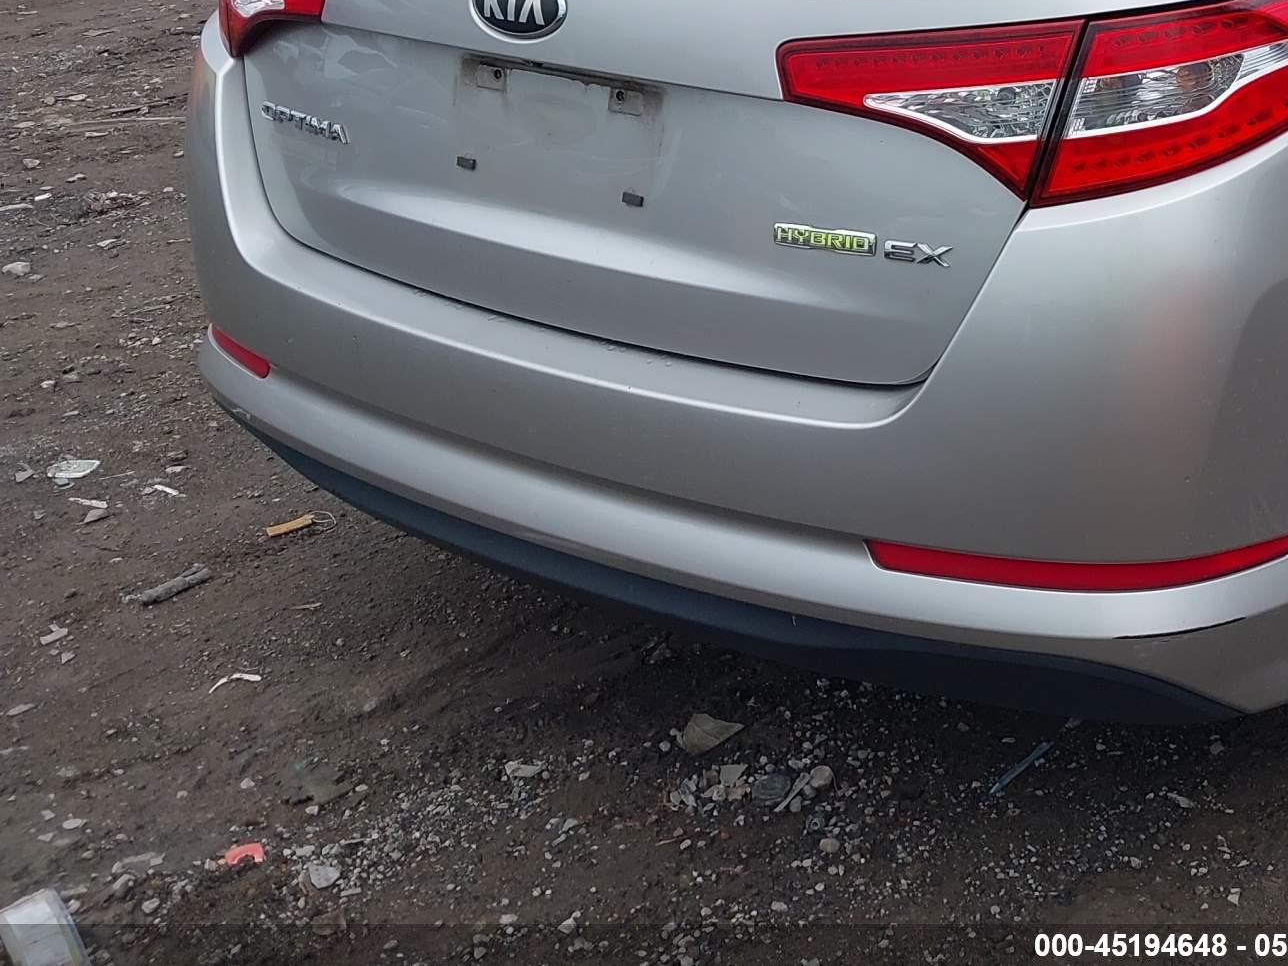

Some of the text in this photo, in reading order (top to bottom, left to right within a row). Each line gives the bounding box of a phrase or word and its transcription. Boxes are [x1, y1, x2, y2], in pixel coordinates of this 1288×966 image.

[261, 100, 350, 144] OPTIMA
[776, 226, 952, 267] HYBRID EX
